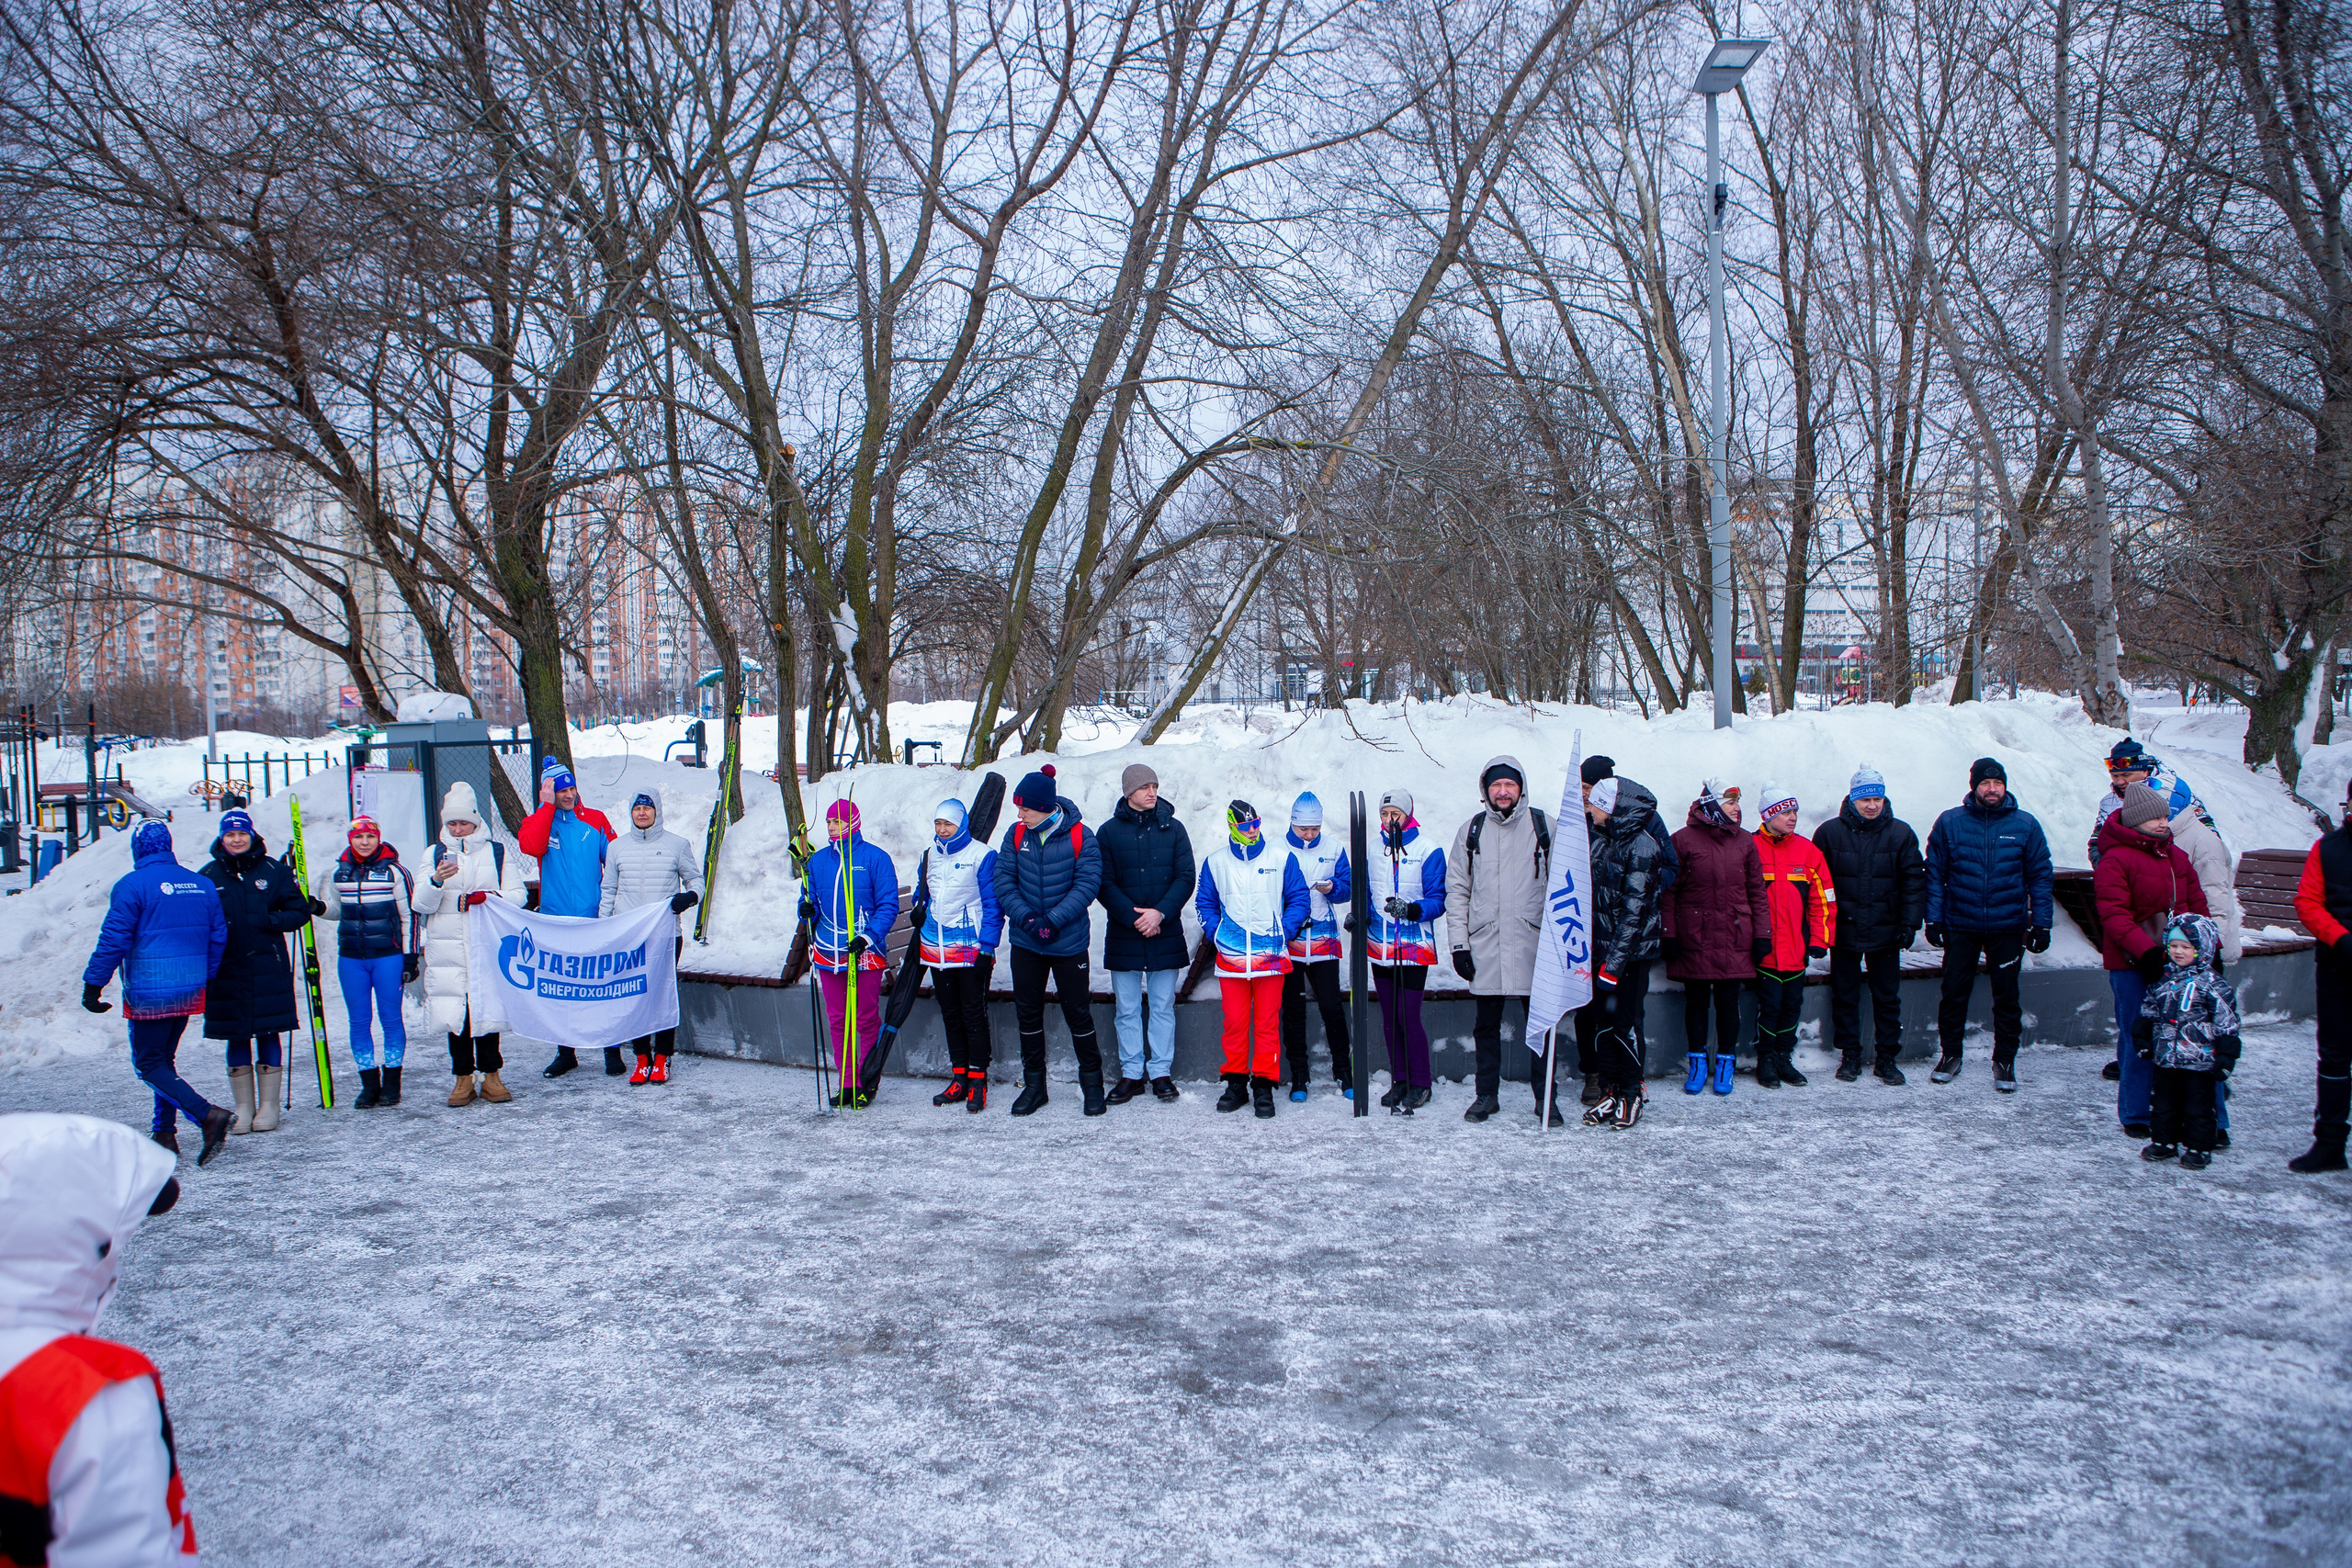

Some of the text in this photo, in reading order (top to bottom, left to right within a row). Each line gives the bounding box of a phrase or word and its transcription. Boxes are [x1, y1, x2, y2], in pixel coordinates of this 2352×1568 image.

[293, 820, 305, 874] FISCHER
[538, 942, 646, 979] ГАЗПРОМ
[540, 978, 643, 998] ЭНЕРГОХОЛДИНГ
